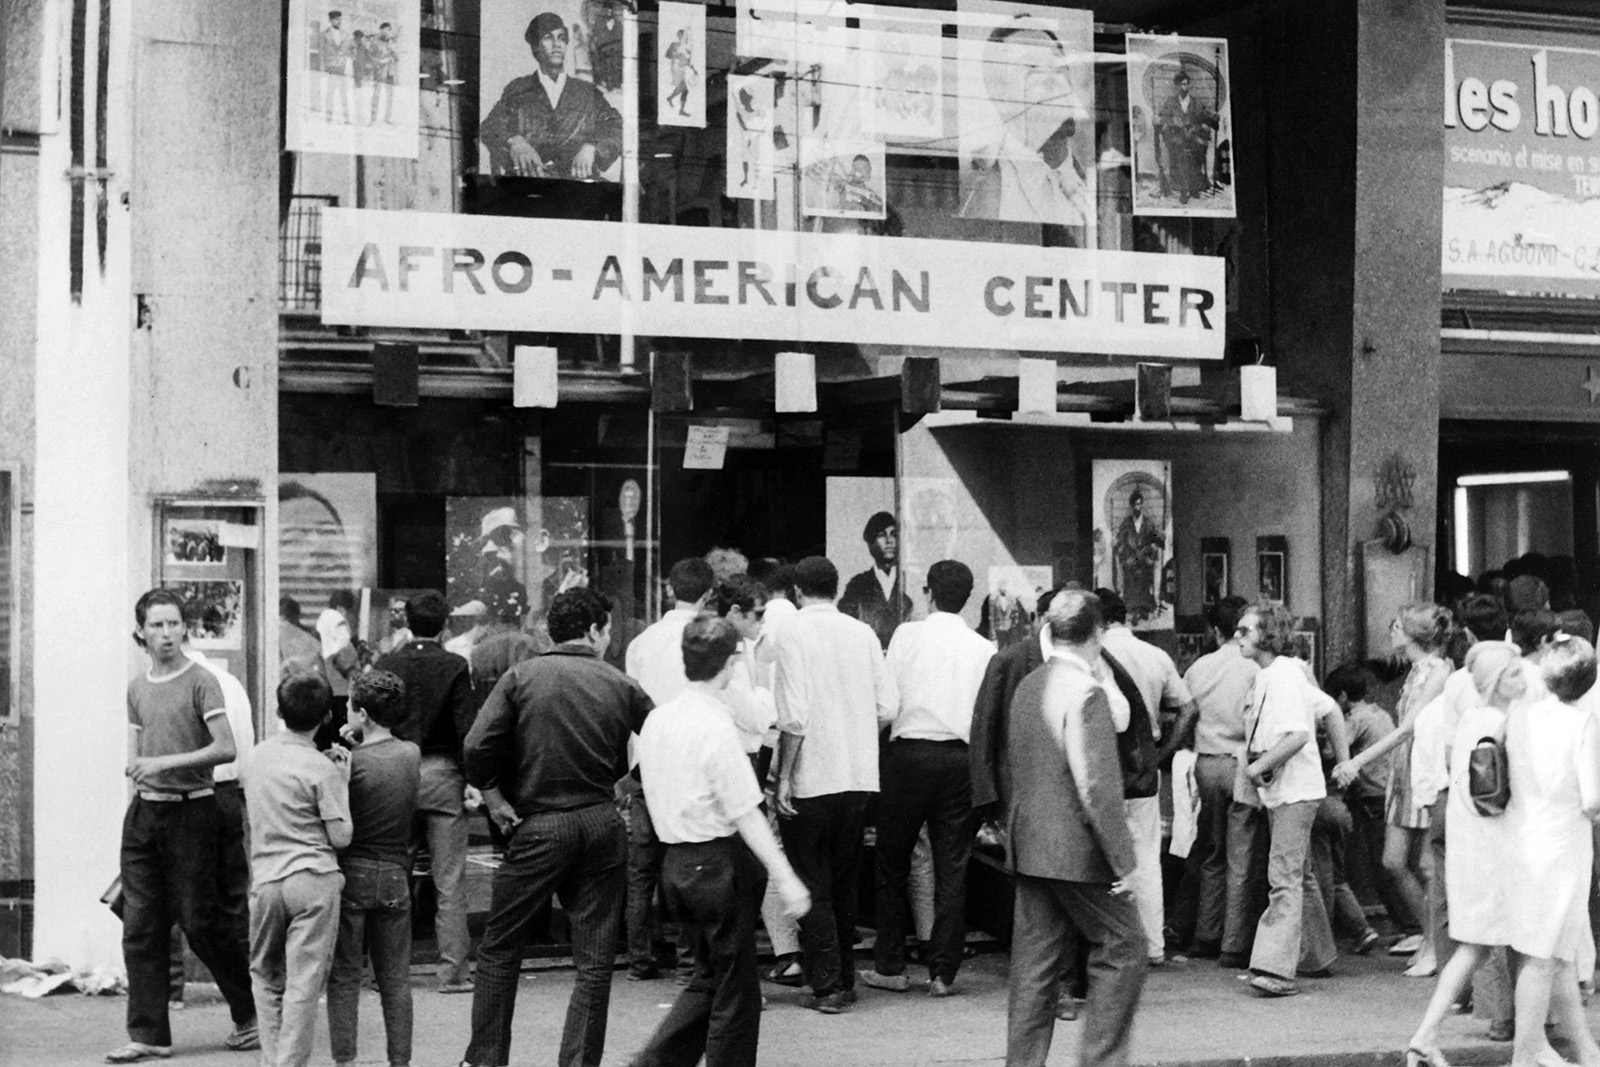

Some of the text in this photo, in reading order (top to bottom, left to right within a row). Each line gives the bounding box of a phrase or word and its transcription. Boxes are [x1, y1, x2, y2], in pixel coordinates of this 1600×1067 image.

[1444, 40, 1600, 140] les ho
[1567, 155, 1584, 172] en
[984, 275, 1215, 331] CENTER
